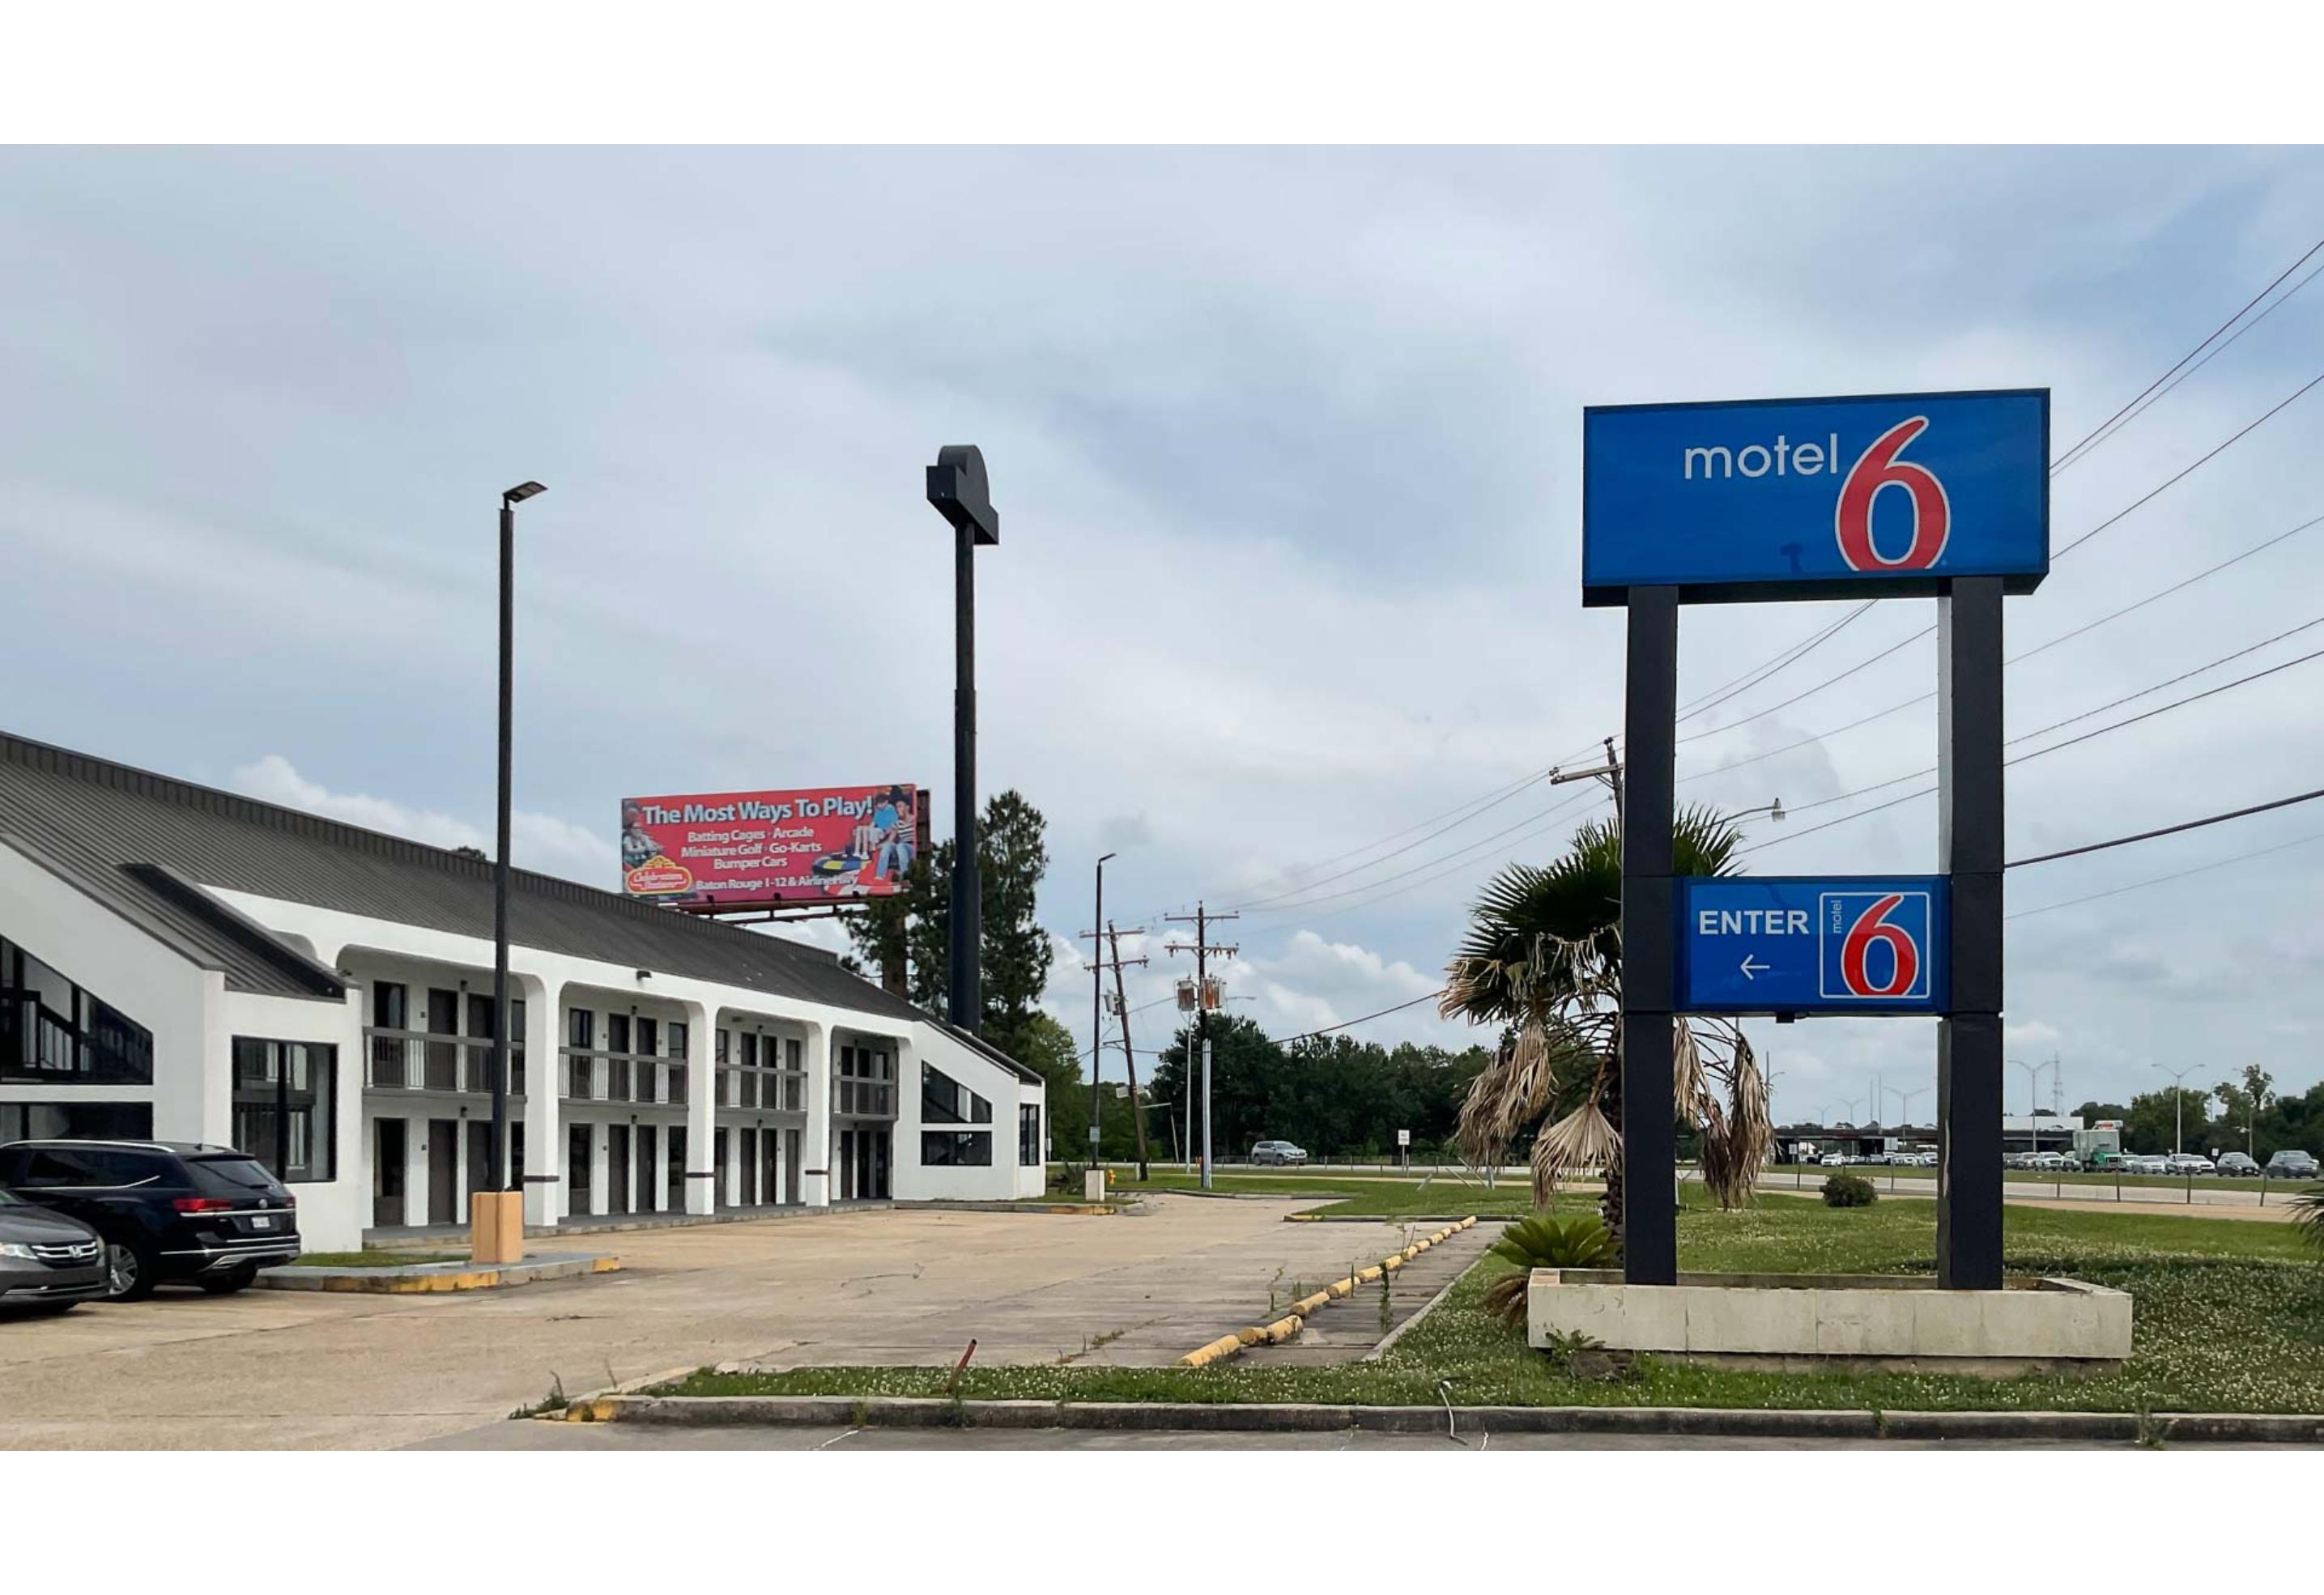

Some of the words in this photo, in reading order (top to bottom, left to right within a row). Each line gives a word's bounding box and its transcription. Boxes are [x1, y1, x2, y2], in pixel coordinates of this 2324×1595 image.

[1684, 432, 1838, 479] motel
[1835, 415, 1952, 571] 6
[642, 806, 682, 825] The
[683, 804, 736, 823] Most
[738, 800, 793, 824] Ways
[794, 798, 820, 818] To
[823, 795, 873, 820] Play!
[687, 831, 730, 844] Batting
[731, 829, 766, 842] Cages
[773, 827, 815, 839] Arcade
[680, 844, 737, 858] Miniature
[738, 843, 764, 856] Golf
[769, 841, 823, 853] Go-Karts
[713, 857, 760, 871] Bumper
[761, 855, 788, 868] Cars
[696, 879, 727, 891] Baton
[727, 878, 763, 891] Rouge
[1699, 909, 1810, 936] ENTER
[1830, 900, 1843, 934] motel
[1841, 892, 1920, 998] 6
